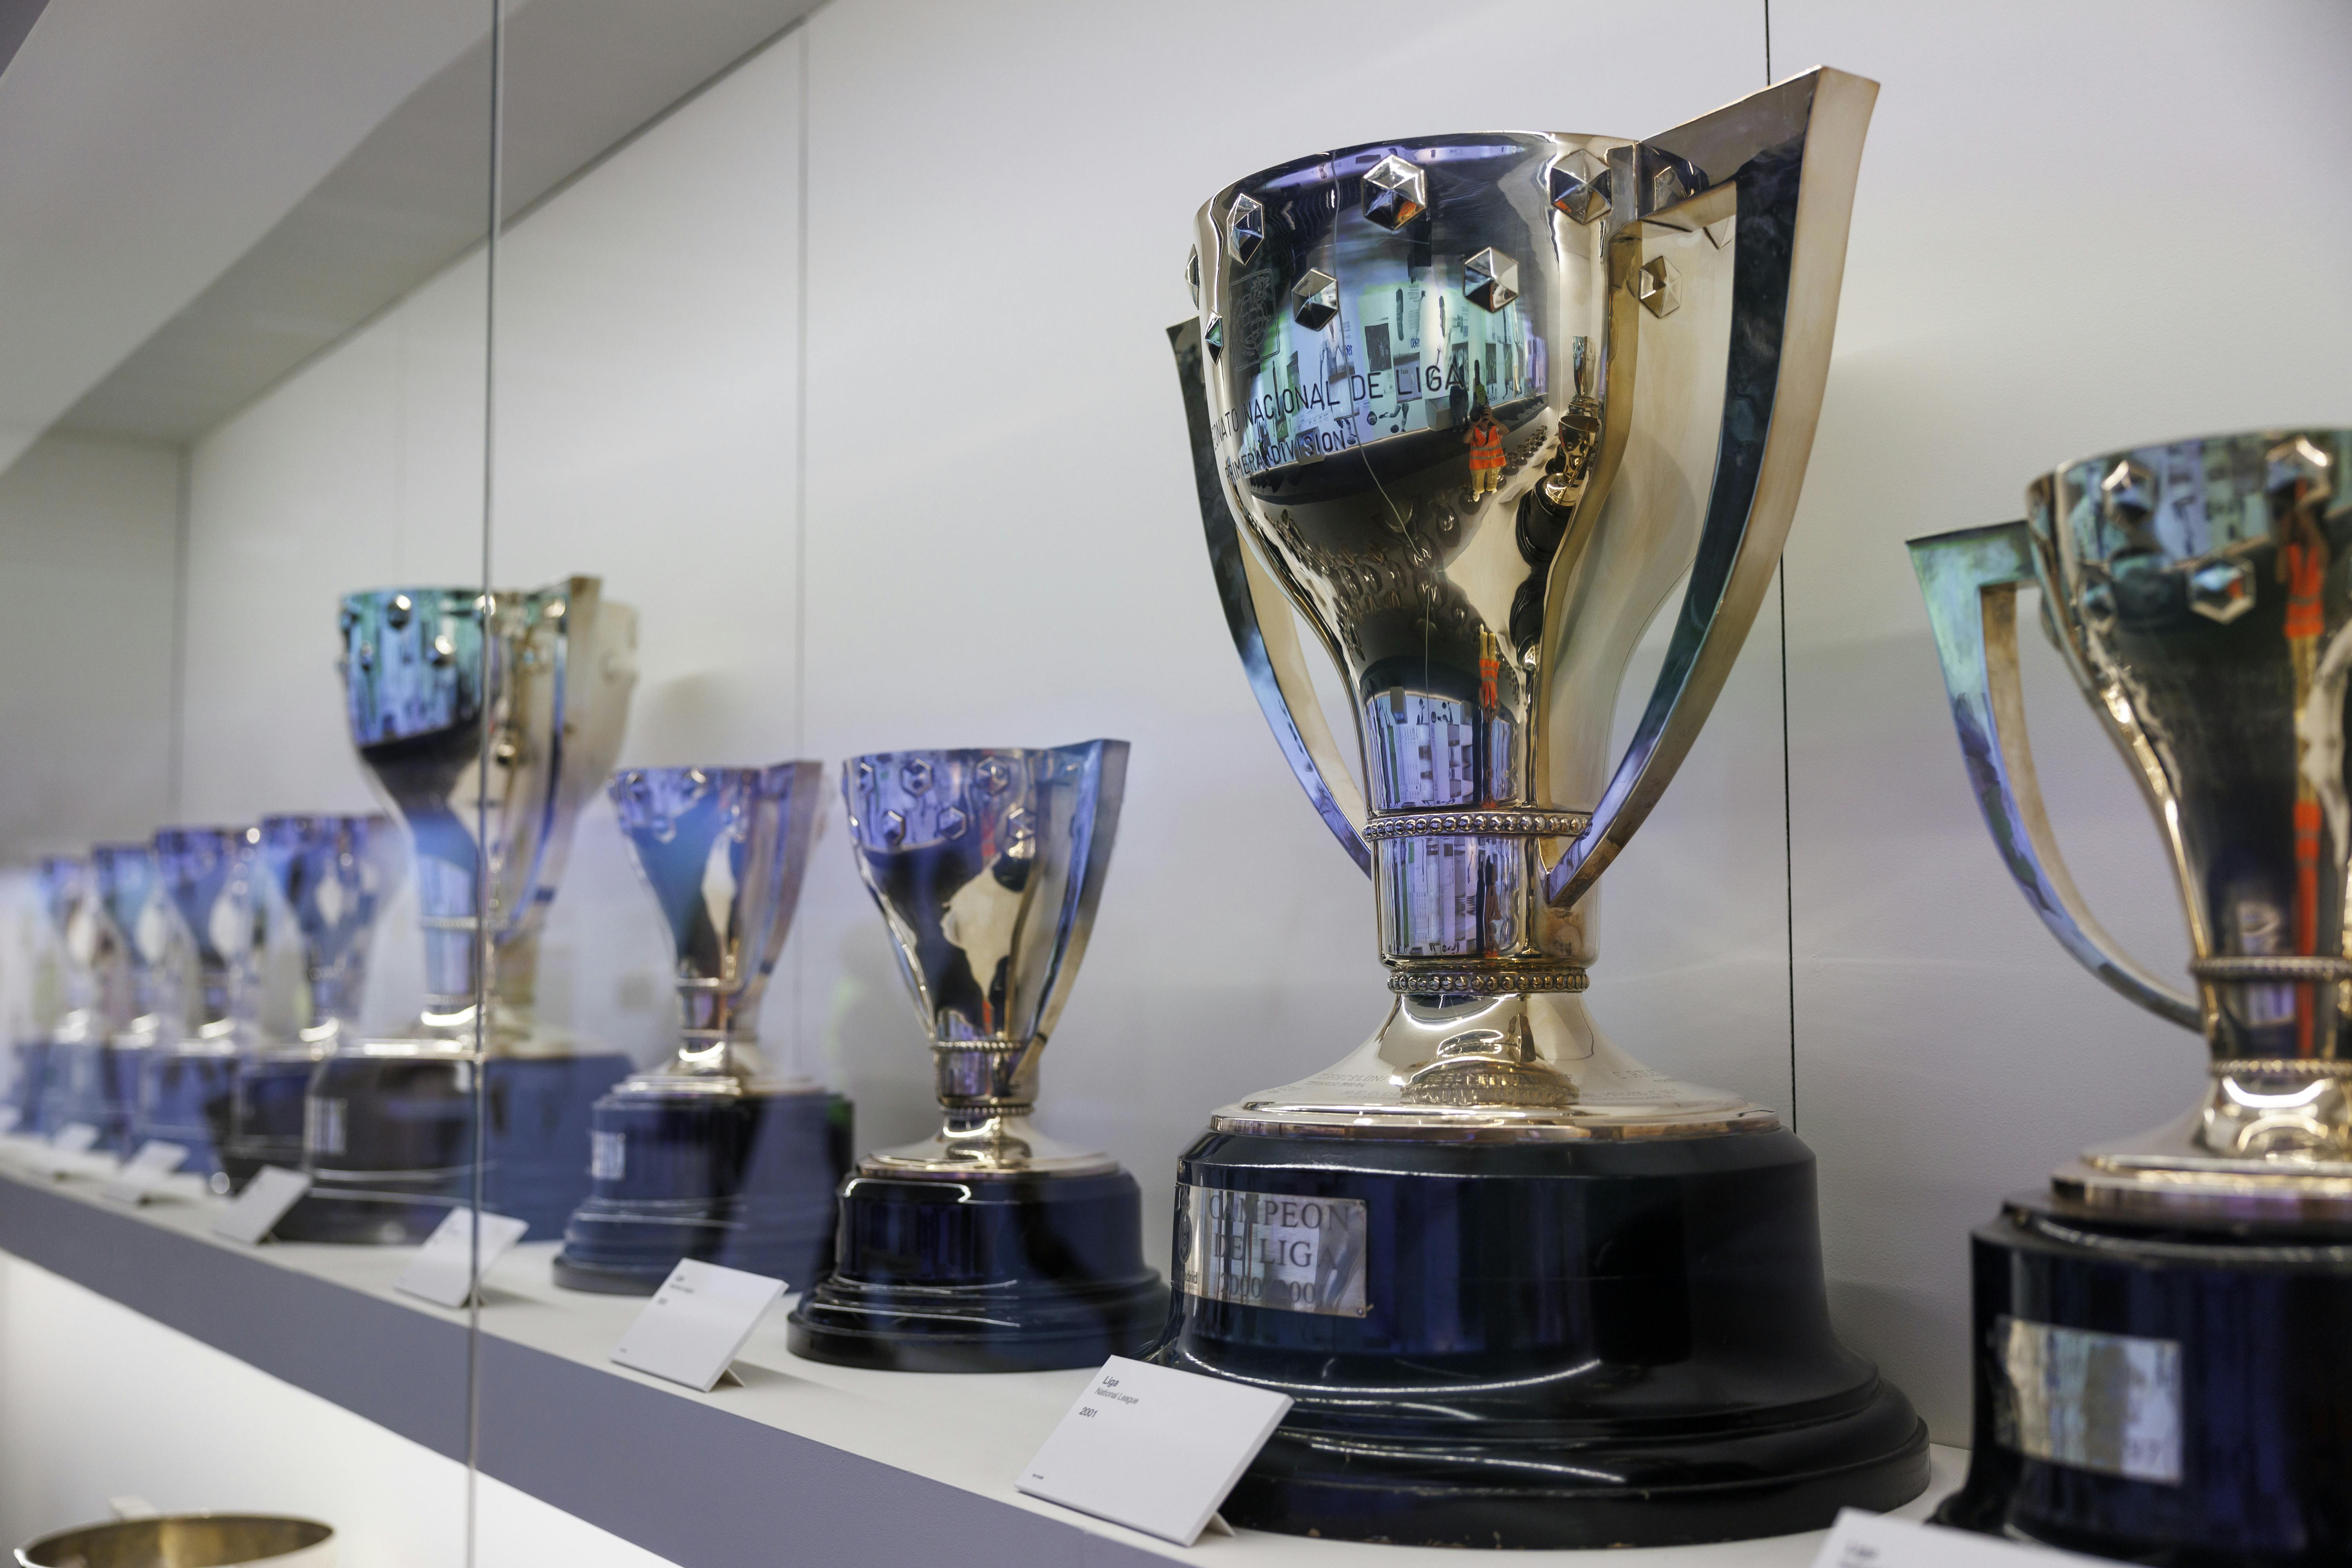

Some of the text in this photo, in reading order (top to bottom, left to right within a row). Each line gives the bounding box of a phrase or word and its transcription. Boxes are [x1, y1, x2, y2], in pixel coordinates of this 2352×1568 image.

[1243, 381, 1340, 428] NACIONAL
[1351, 372, 1384, 401] DE
[1396, 364, 1464, 395] LIGA
[1225, 430, 1346, 486] PRIMERA DIVISION
[1215, 1233, 1337, 1268] DE LIGA
[1102, 1376, 1119, 1387] Liga
[1094, 1387, 1139, 1404] National League
[1079, 1407, 1098, 1418] 2001
